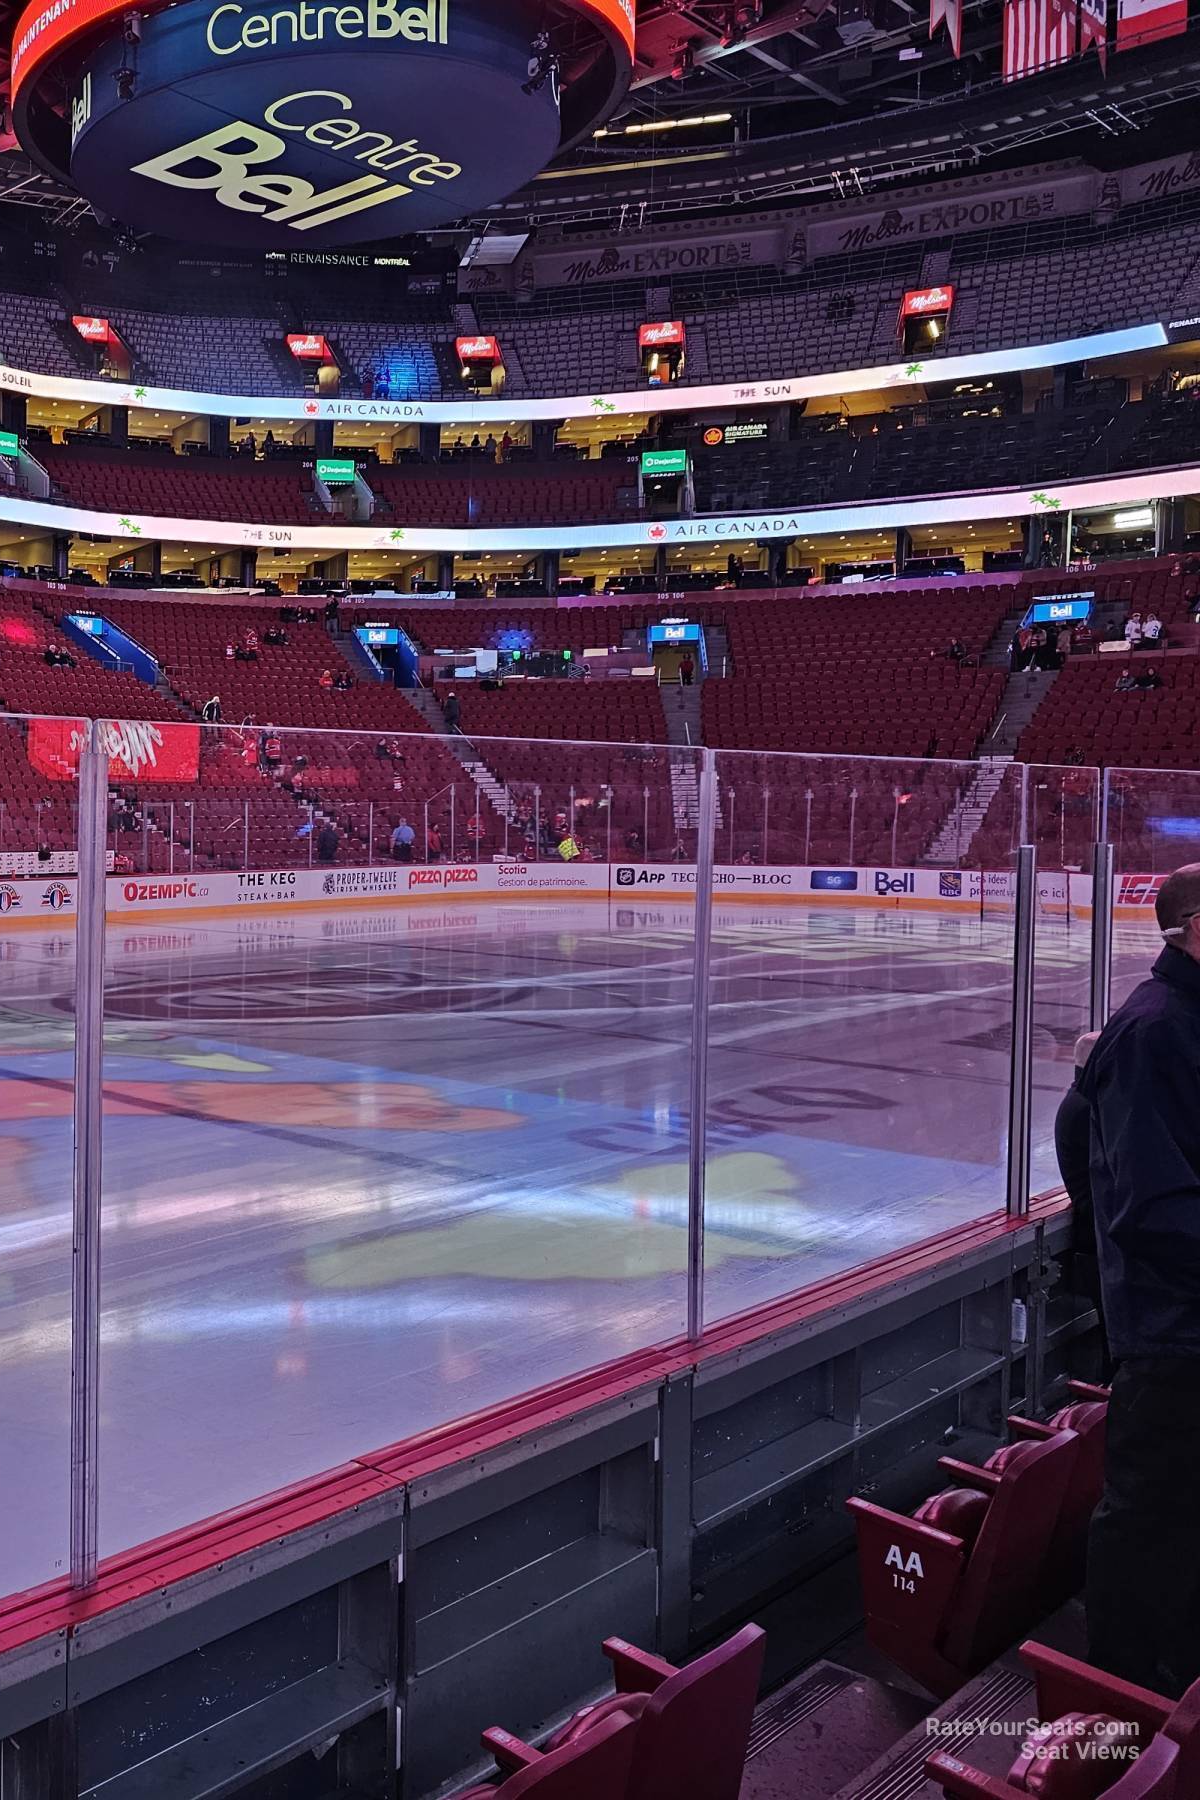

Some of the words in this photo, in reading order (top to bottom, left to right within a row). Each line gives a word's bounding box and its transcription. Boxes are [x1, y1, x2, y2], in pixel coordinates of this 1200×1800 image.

[19, 0, 77, 57] MAINTENAN
[72, 72, 92, 147] Bell
[264, 90, 462, 186] Centre
[129, 120, 413, 231] Bell
[839, 217, 914, 250] Molson
[918, 196, 1024, 234] EXPORT
[1043, 191, 1055, 212] ALE
[290, 253, 370, 266] RENAISSANCE
[563, 256, 631, 282] Molson
[633, 244, 727, 273] EXPORT
[740, 241, 752, 261] ALE
[108, 262, 115, 274] 7
[909, 293, 948, 309] Molson
[78, 322, 105, 335] Molson
[642, 326, 679, 340] Molson
[290, 340, 320, 352] Molson
[458, 341, 490, 353] Molson
[2, 371, 33, 387] SOLEIL
[733, 388, 756, 398] THE
[764, 384, 791, 396] SUN
[326, 404, 352, 415] AIR
[357, 403, 424, 416] CANADA
[739, 423, 768, 432] CANADA
[653, 457, 682, 466] Desjardins
[326, 465, 352, 475] Desjardins
[675, 523, 708, 537] AIR
[714, 518, 799, 535] CANADA
[269, 530, 292, 541] SUN
[1065, 564, 1079, 573] 106
[1084, 563, 1097, 571] 107
[672, 592, 684, 600] 106
[1049, 605, 1073, 618] Bell
[368, 630, 386, 641] Bell
[665, 626, 685, 638] Bell
[498, 864, 527, 875] Scotia
[237, 874, 265, 887] THE
[270, 871, 297, 885] KEG
[408, 870, 442, 890] pizza
[444, 869, 478, 887] pizza
[497, 877, 526, 887] Gestion
[528, 878, 538, 886] de
[874, 871, 915, 893] Bell
[362, 884, 397, 892] WHISKEY
[941, 889, 961, 897] RBC
[1051, 888, 1065, 898] ici
[884, 1544, 925, 1578] AA
[892, 1573, 916, 1595] 114
